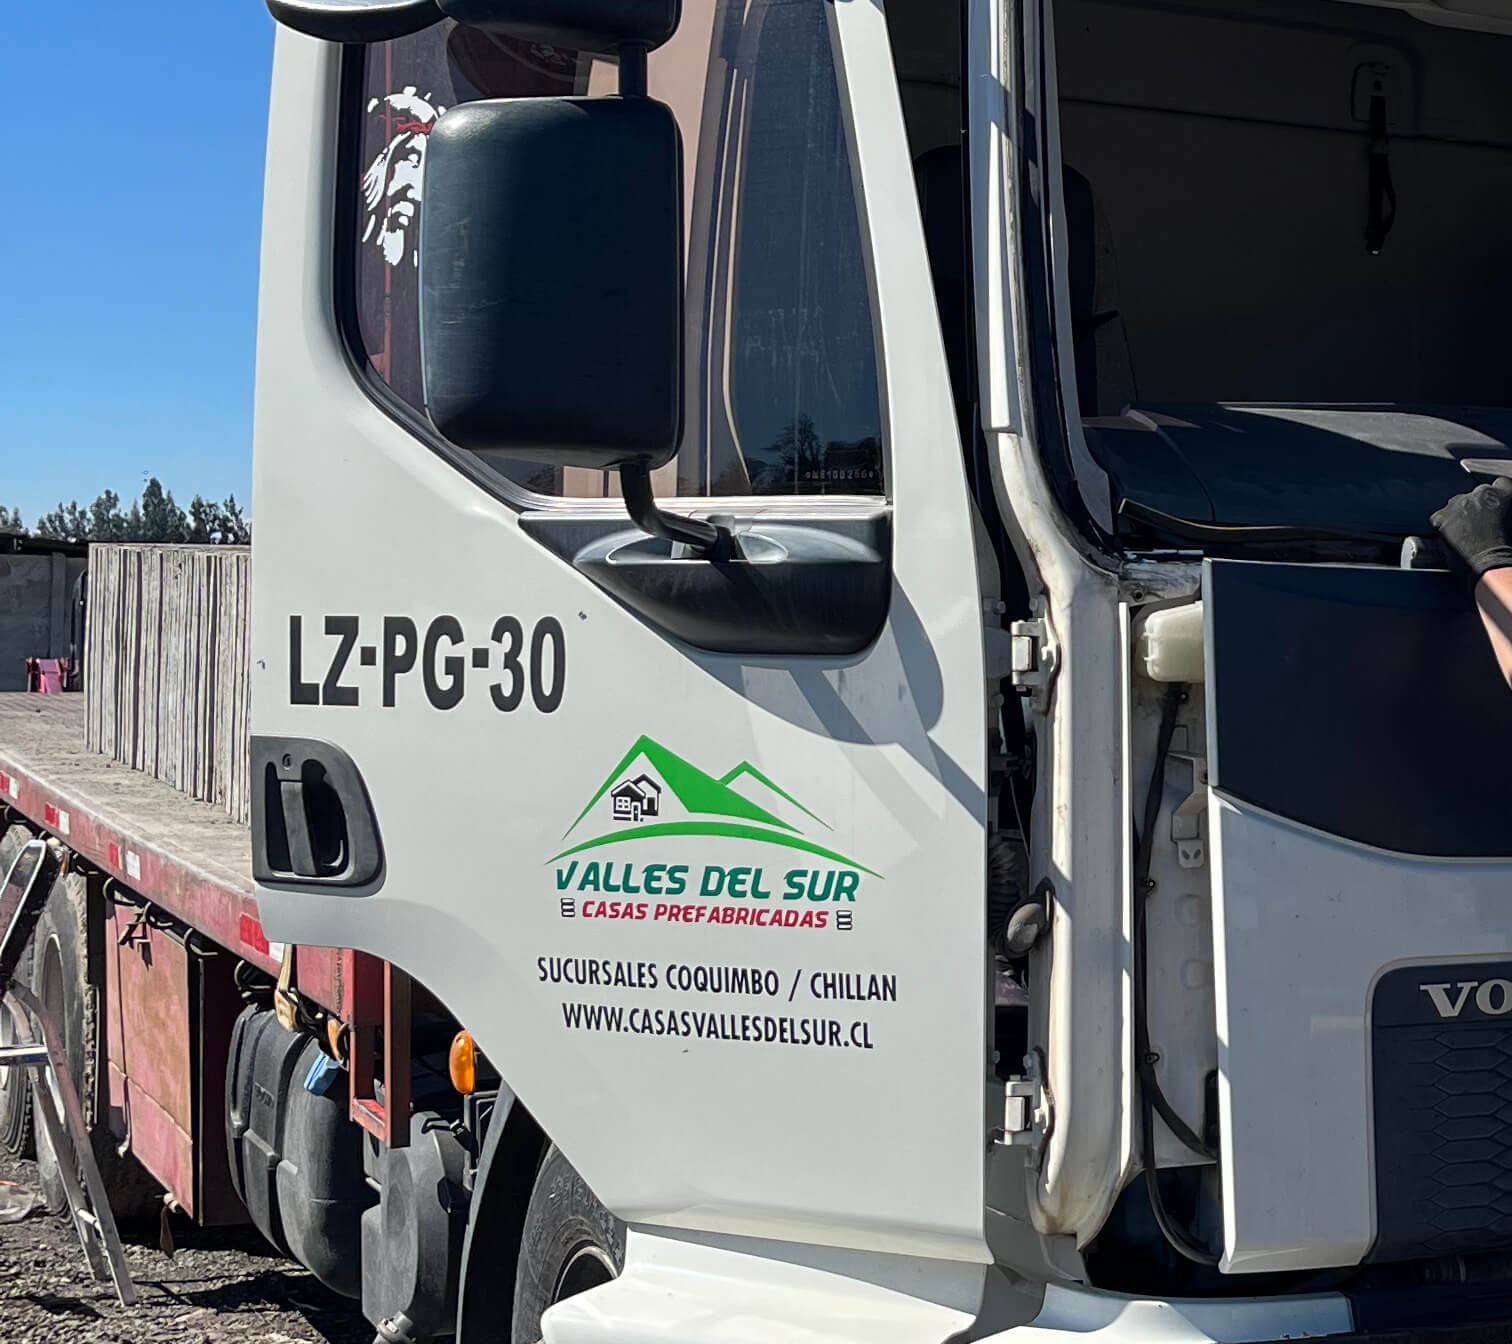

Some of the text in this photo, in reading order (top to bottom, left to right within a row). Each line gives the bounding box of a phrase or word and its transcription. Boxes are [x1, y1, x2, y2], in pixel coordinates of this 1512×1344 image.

[289, 614, 566, 713] LZ-PG-30
[556, 861, 861, 902] VALLES DEL SUR
[582, 900, 829, 929] CASAS PREFABRICADAS
[537, 956, 897, 1002] SUCURSALES COQUIMBO / CHILLAN
[561, 1002, 874, 1049] WWW.CASASVALLESDELSUR.CL
